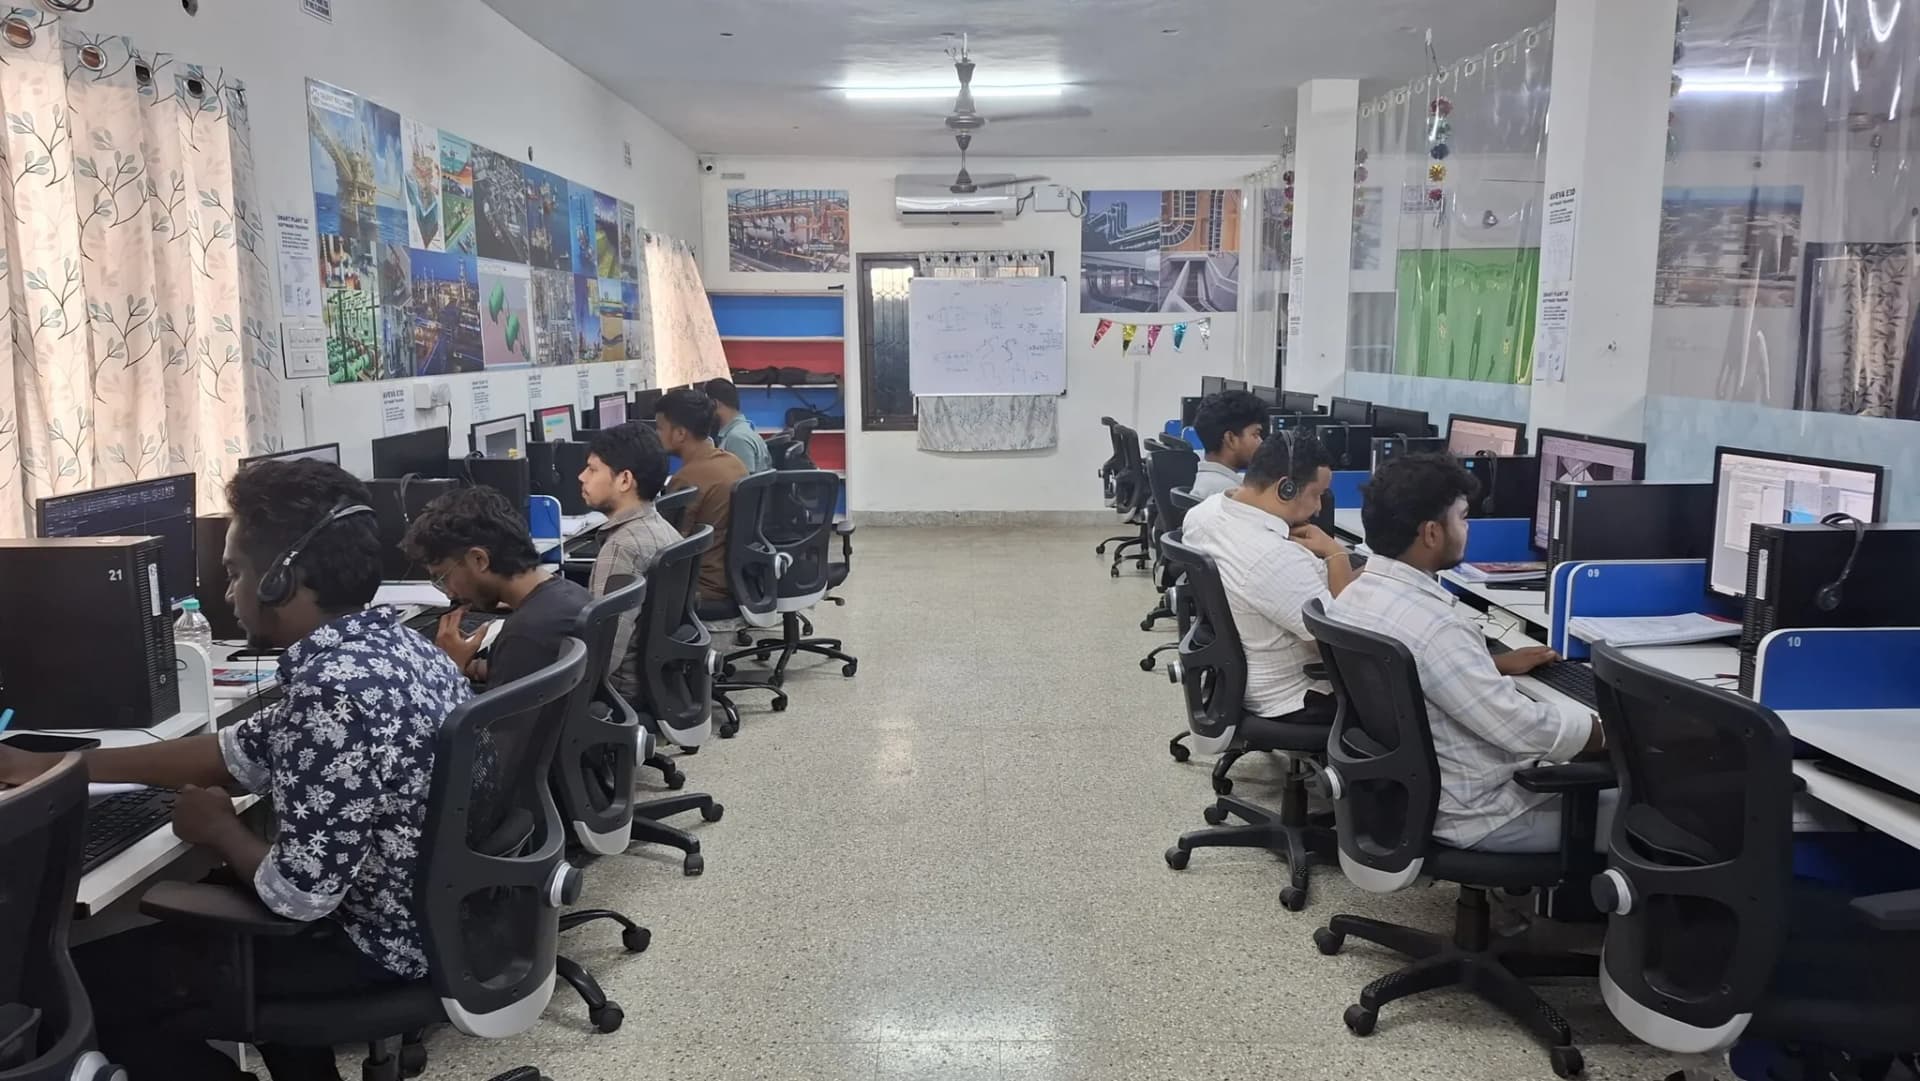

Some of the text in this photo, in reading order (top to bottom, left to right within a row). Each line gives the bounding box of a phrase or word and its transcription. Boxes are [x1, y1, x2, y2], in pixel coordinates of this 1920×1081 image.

[108, 568, 122, 581] 21
[1587, 568, 1600, 578] 09
[1786, 636, 1801, 648] 10
